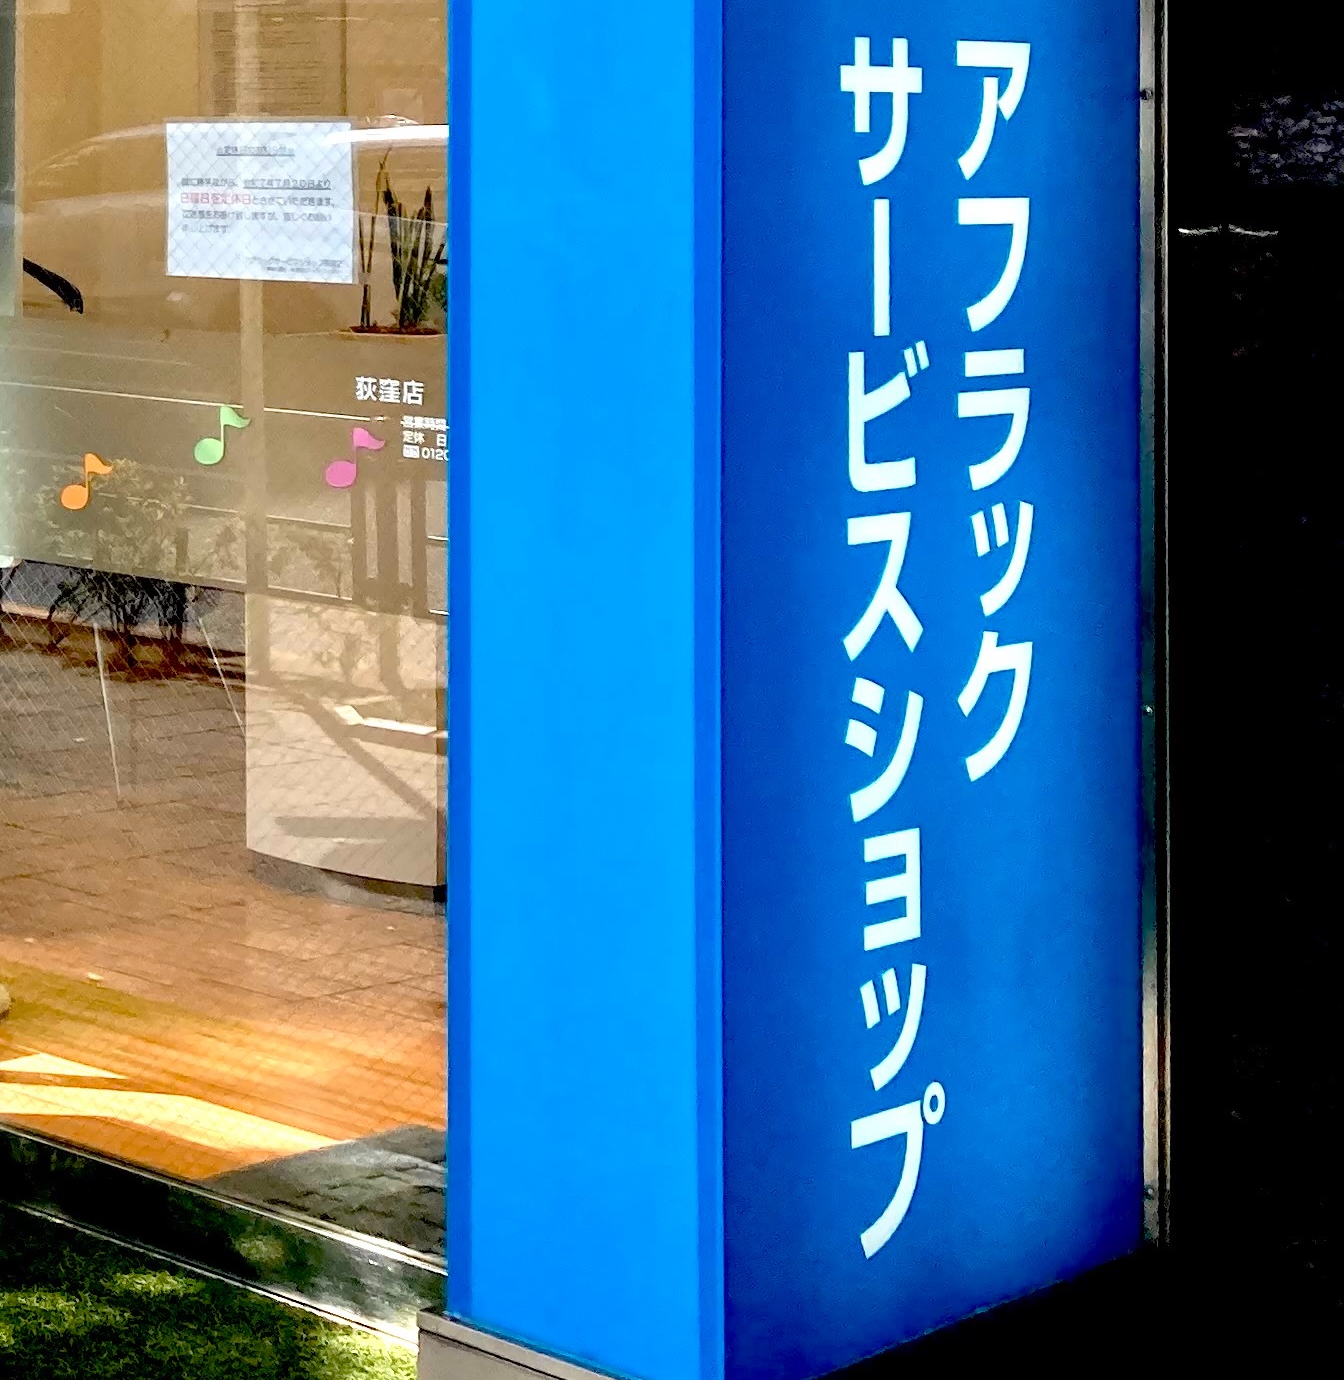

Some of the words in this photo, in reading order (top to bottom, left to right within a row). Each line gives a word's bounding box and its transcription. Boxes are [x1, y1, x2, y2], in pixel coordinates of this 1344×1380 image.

[355, 376, 424, 406] 荻窪店
[839, 35, 949, 1261] サービスショップ
[954, 38, 1034, 783] アフラック
